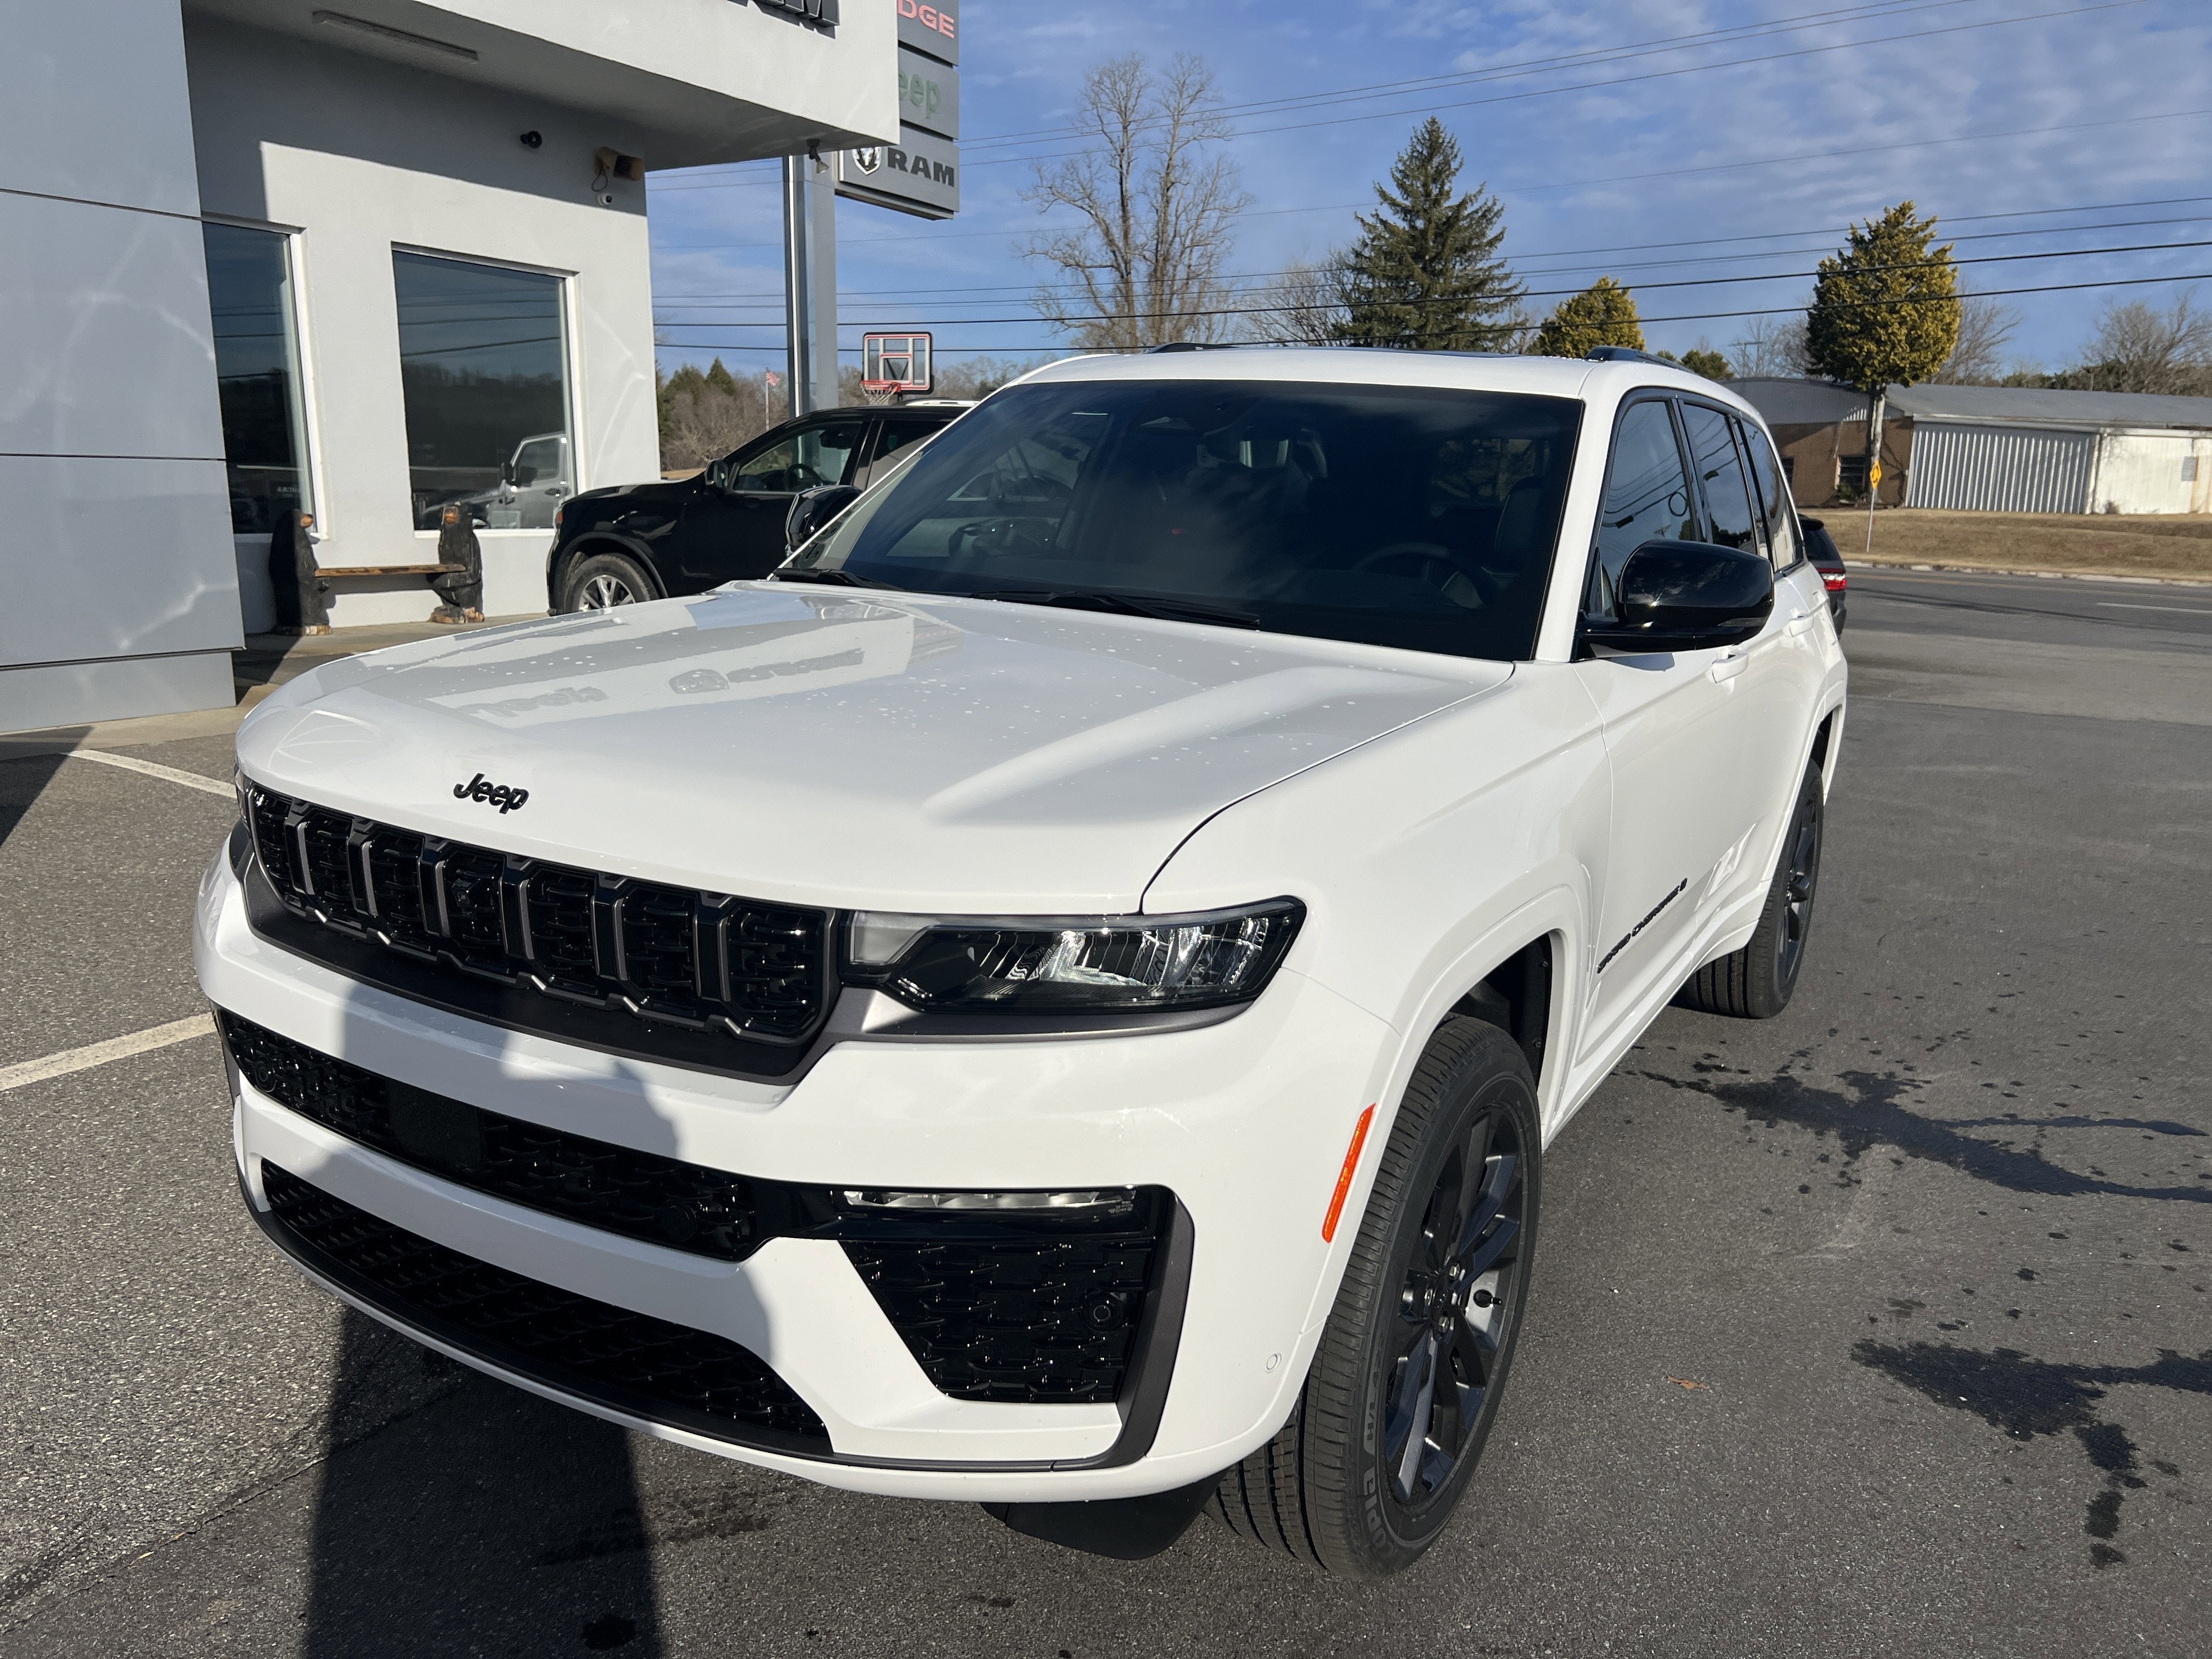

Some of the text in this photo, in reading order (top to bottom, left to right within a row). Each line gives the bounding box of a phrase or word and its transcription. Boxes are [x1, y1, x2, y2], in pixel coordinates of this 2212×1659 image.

[898, 0, 955, 39] DGE
[899, 70, 941, 119] eep
[888, 147, 955, 188] RAM
[453, 772, 529, 815] Jeep
